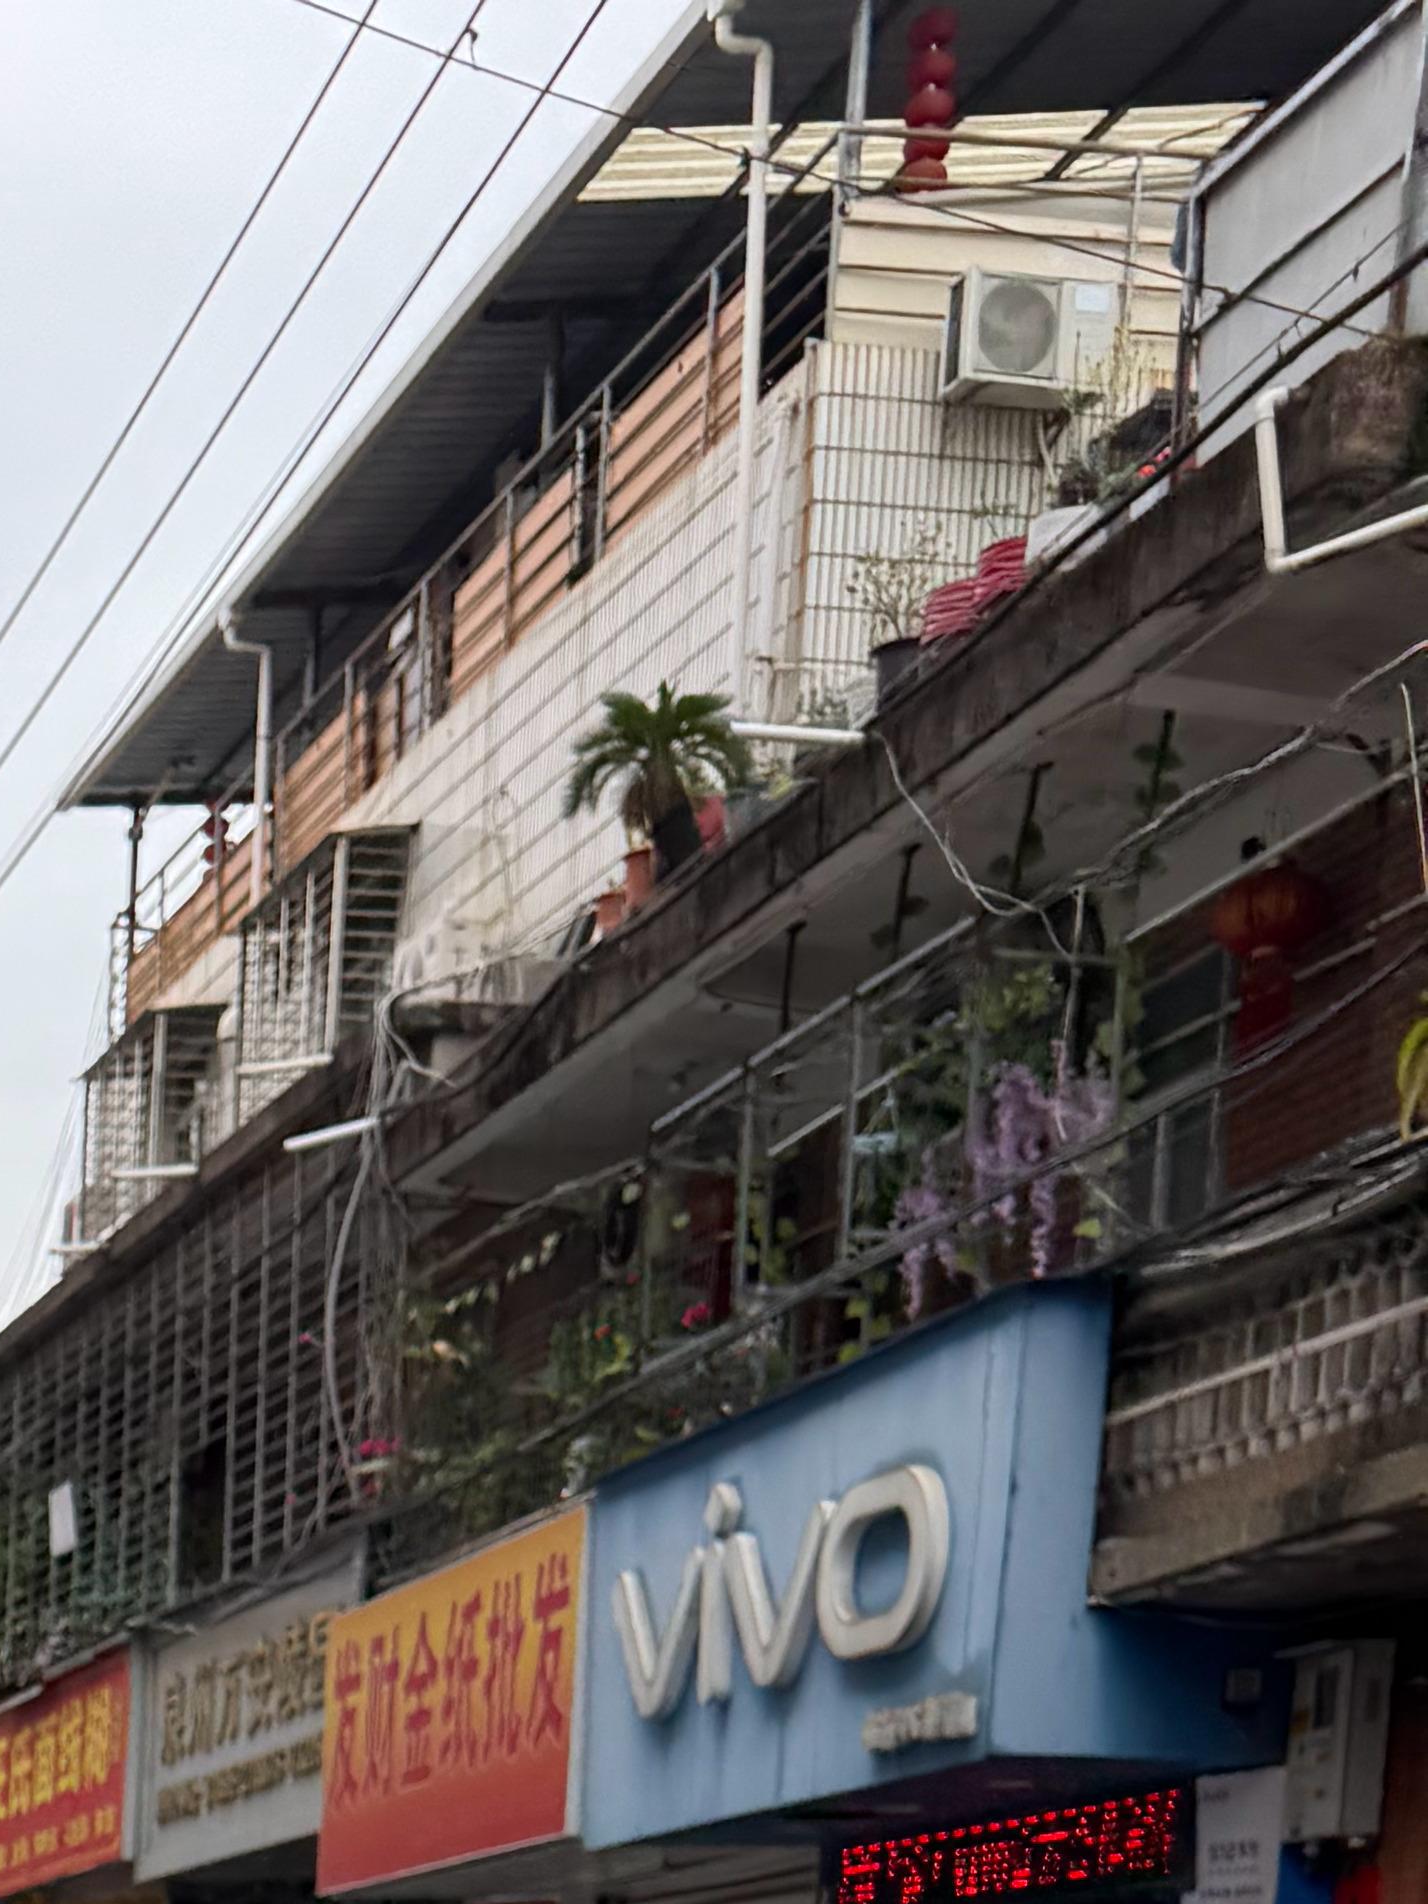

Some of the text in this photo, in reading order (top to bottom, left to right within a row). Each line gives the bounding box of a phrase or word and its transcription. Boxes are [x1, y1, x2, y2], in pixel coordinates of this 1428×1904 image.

[328, 1553, 570, 1798] 发财金纸批发
[613, 1462, 949, 1722] vivo
